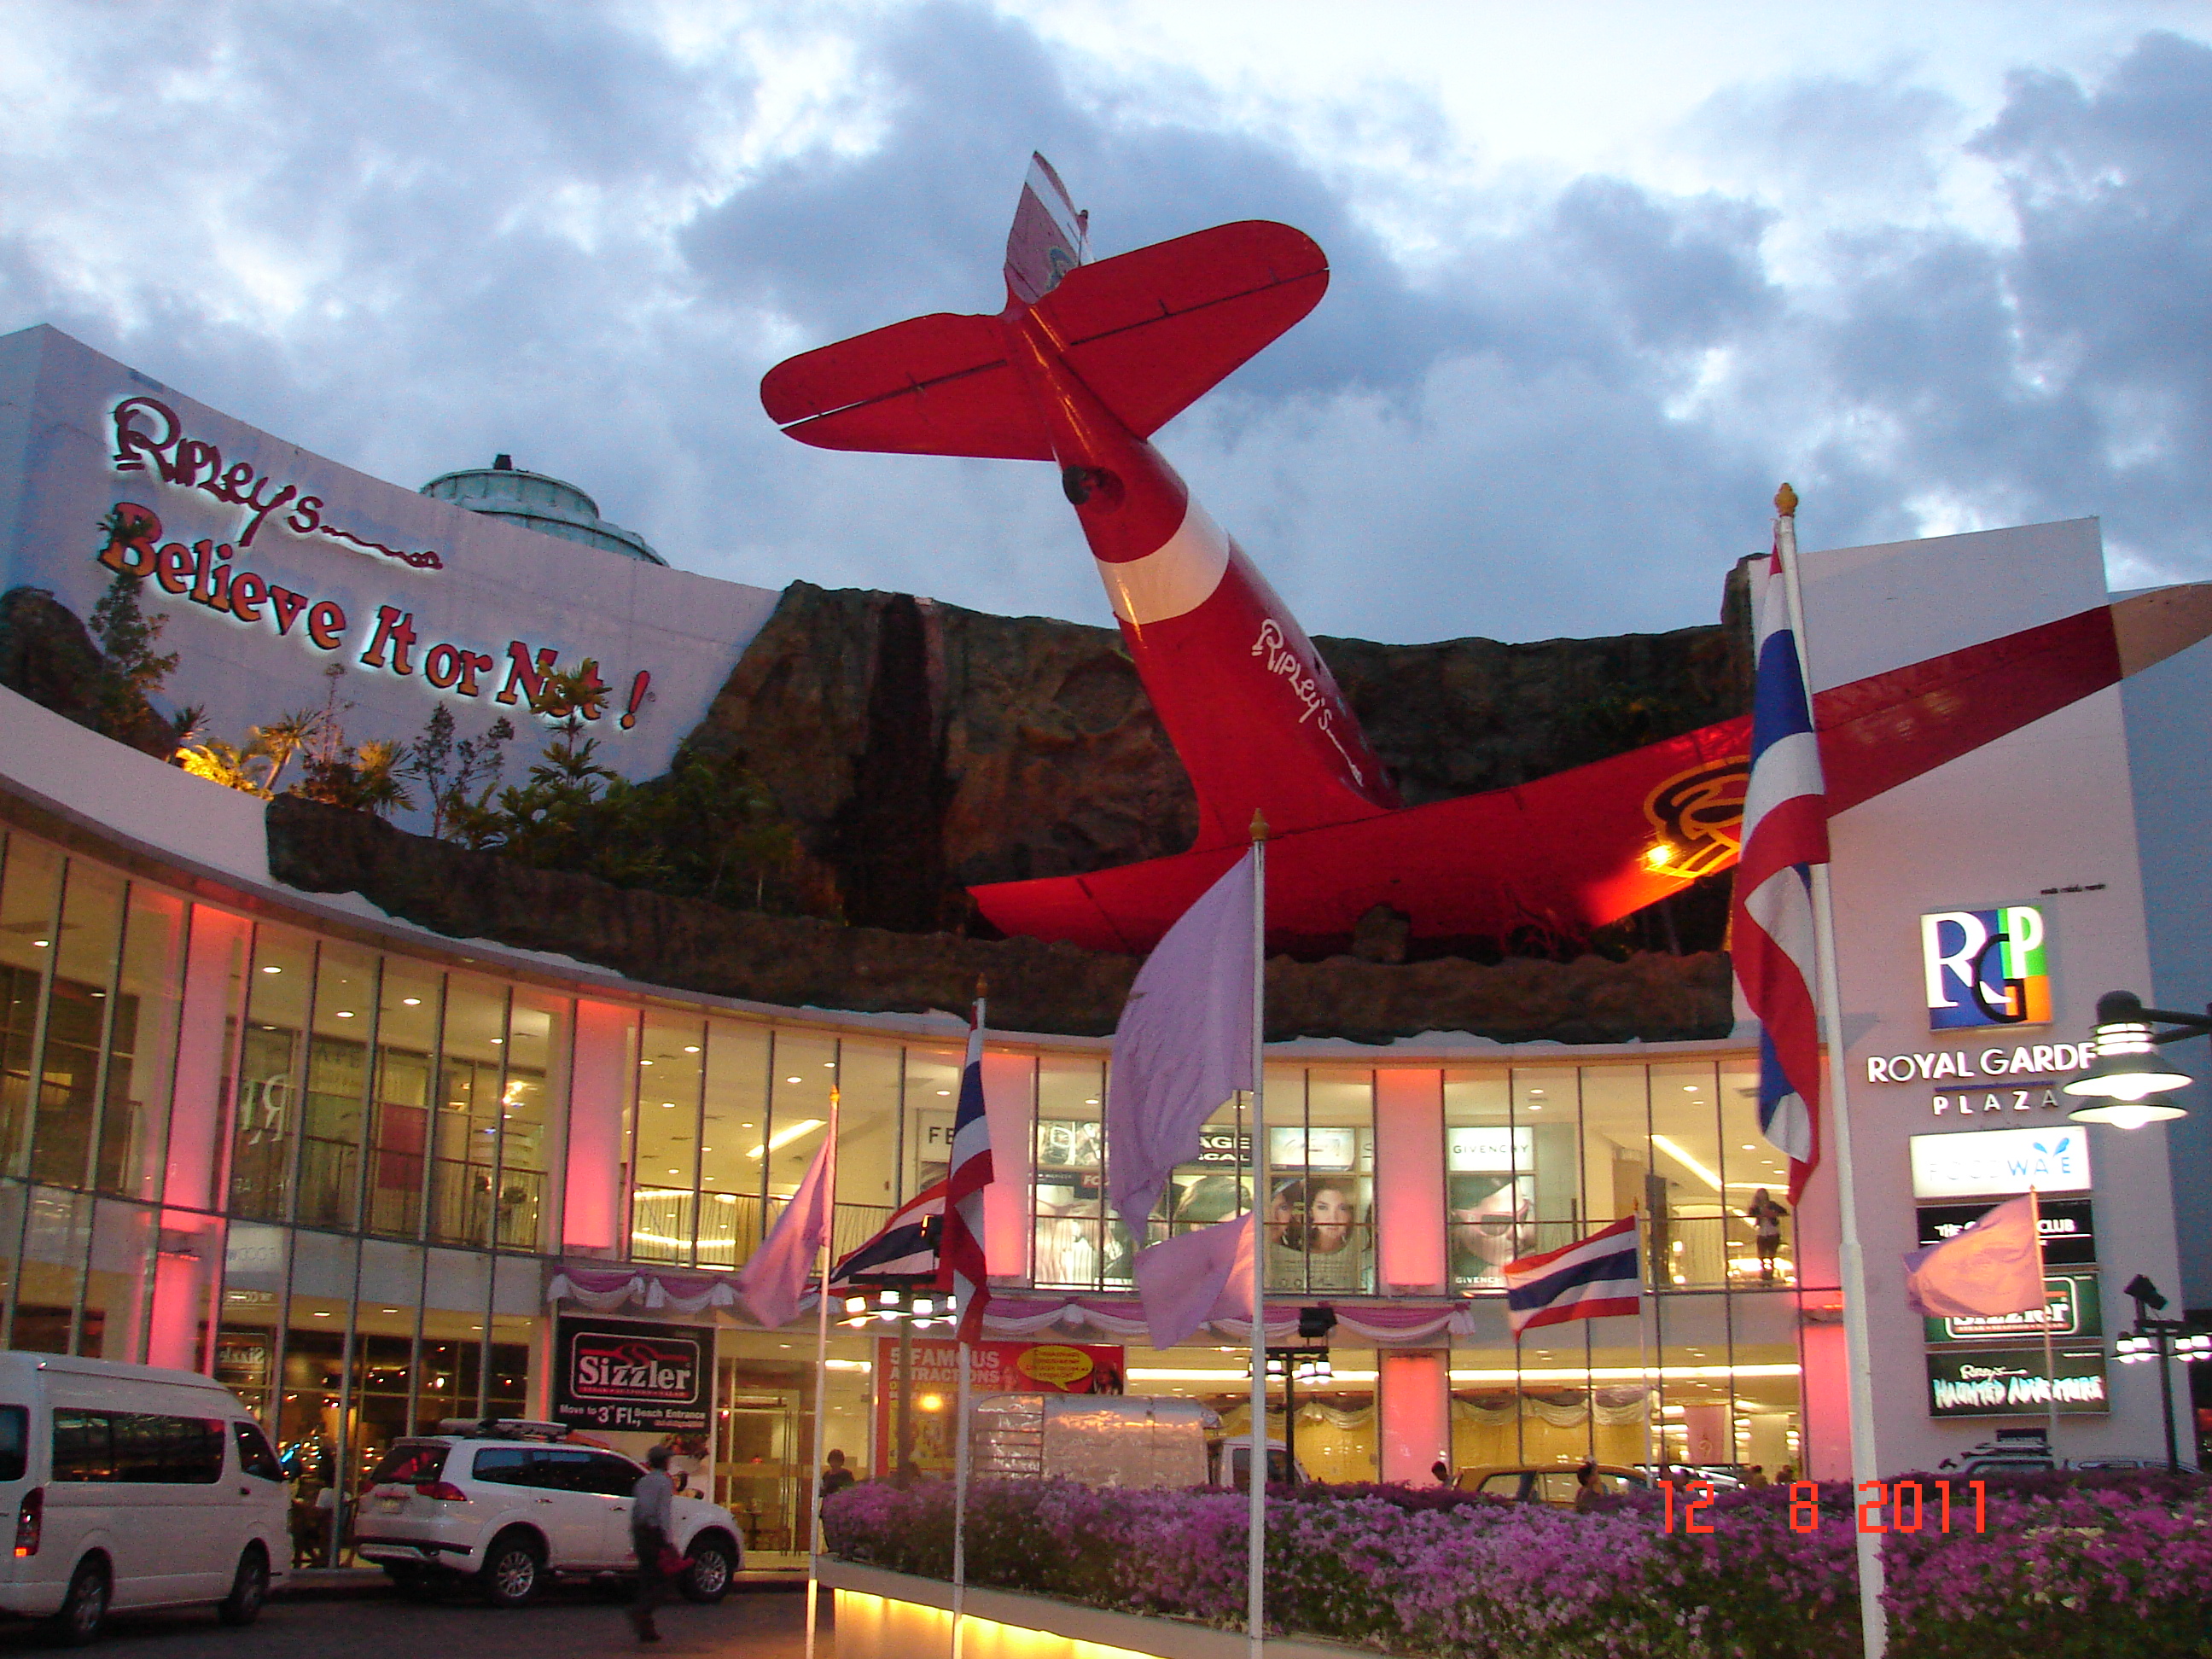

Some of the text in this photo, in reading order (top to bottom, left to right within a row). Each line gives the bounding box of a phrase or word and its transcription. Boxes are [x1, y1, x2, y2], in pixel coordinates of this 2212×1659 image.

[98, 502, 346, 650] Believe
[360, 604, 417, 676] It
[426, 643, 493, 696] or
[1867, 1042, 2098, 1083] ROYAL GARDE
[1933, 1089, 2058, 1115] PLAZA
[2036, 1219, 2076, 1232] CLUB
[1455, 1276, 1506, 1284] GIVENCH
[911, 1348, 1000, 1370] FAMUS
[578, 1355, 691, 1390] Sizzler
[889, 1367, 1000, 1384] ATRACTONS
